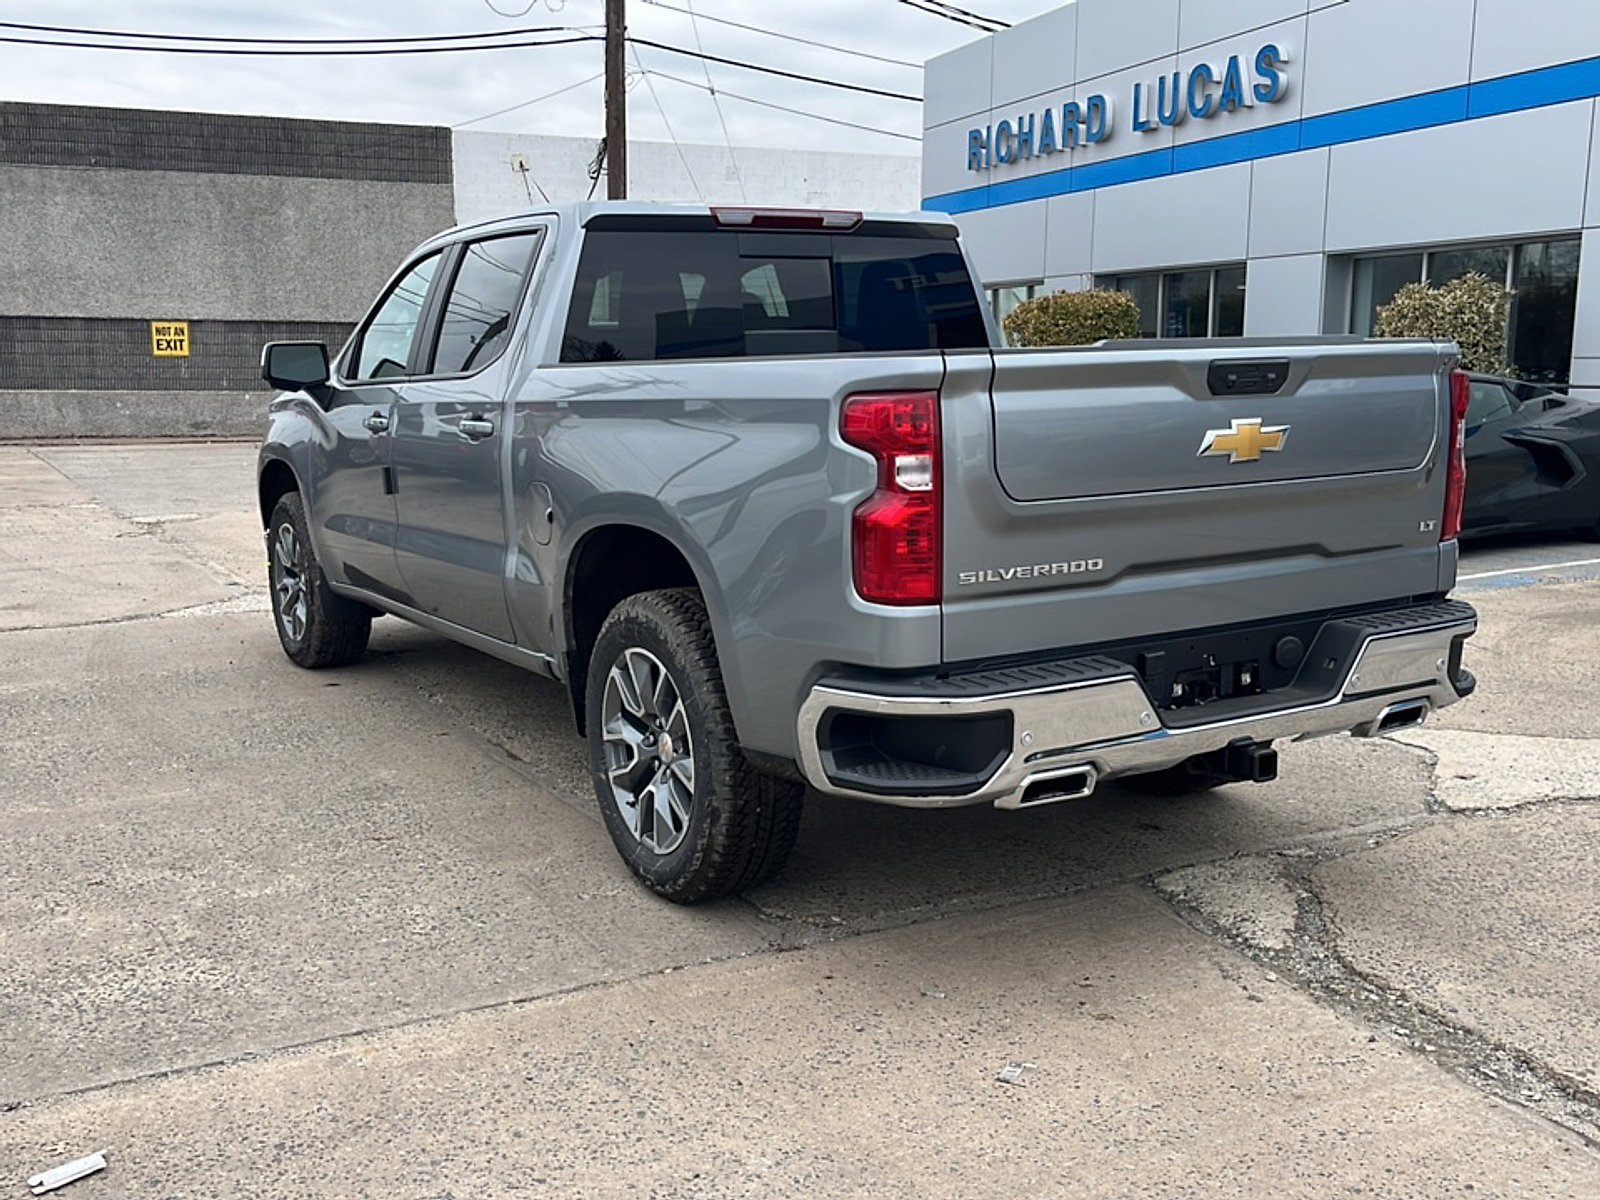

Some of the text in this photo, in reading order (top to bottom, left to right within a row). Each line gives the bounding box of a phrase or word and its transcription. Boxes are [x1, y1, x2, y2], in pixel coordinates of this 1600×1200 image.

[967, 43, 1288, 171] RICHARD LUCAS
[155, 326, 185, 337] NOT AN
[156, 338, 185, 351] EXIT
[1420, 520, 1437, 531] LT
[958, 558, 1104, 585] SILVERADO
